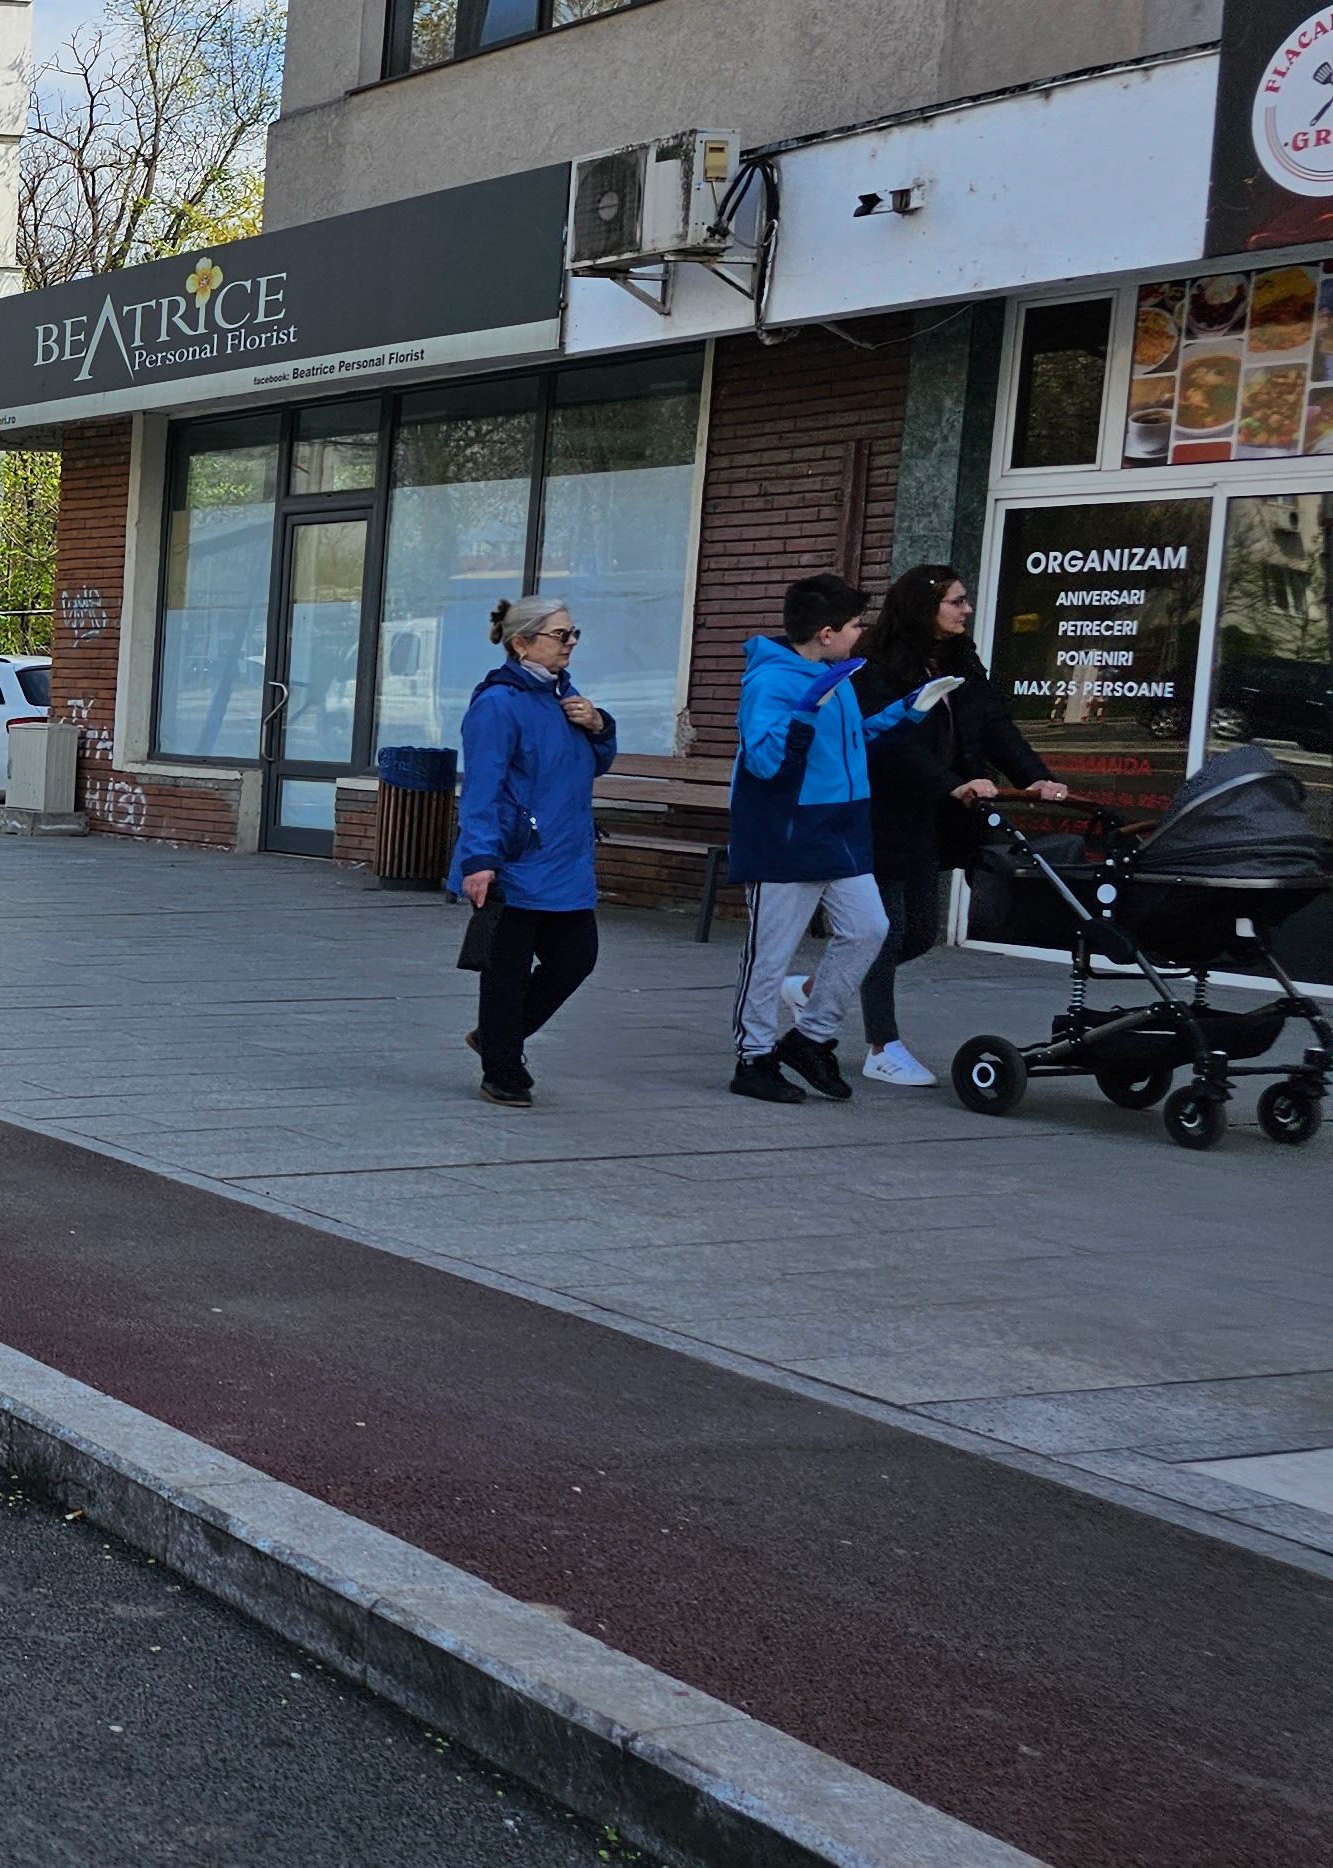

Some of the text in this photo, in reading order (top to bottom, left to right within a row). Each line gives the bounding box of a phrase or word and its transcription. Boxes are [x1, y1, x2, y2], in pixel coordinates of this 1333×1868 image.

[1264, 14, 1333, 93] FLACA
[34, 273, 287, 382] BEATRICE
[133, 324, 298, 371] Personal Florist
[253, 349, 425, 386] facebook: Beatrice Personal Florist
[1026, 546, 1188, 575] ORGANIZAM
[1055, 589, 1146, 606] ANIVERSARI
[1058, 620, 1139, 636] PETRECERI
[1056, 650, 1134, 666] POMENIRI
[1013, 680, 1175, 698] MAX 25 PERSOANE
